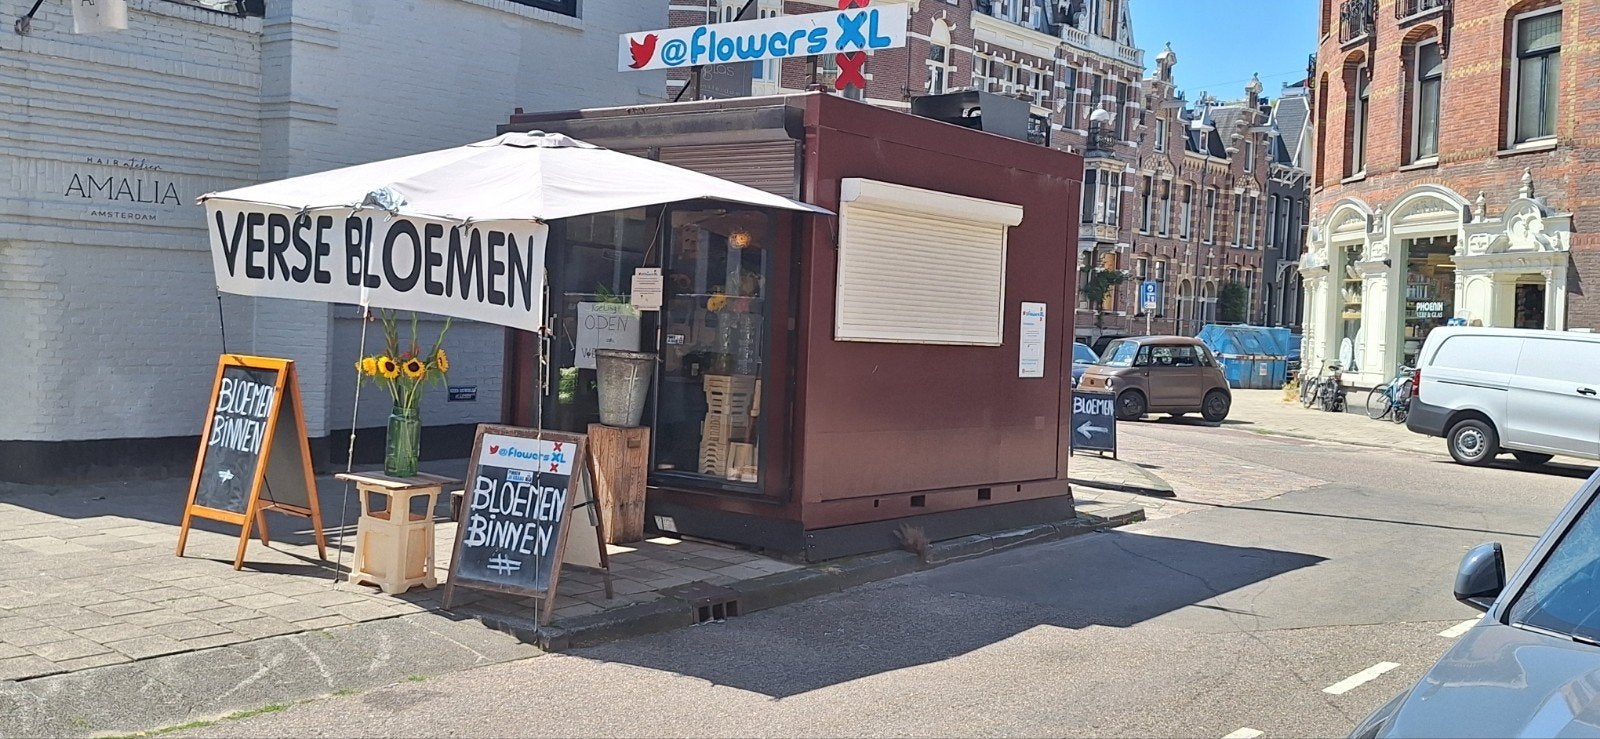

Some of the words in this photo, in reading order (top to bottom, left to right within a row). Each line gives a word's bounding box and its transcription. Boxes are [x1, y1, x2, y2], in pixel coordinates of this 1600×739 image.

[87, 157, 119, 167] HAIR
[123, 158, 162, 171] atelier
[64, 173, 181, 206] AMALIA
[91, 210, 157, 221] AMSTERDAM
[216, 210, 333, 284] VERSE
[345, 216, 534, 312] BLOEMEN
[216, 377, 276, 418] BLOEMEN
[1073, 396, 1115, 416] BLOEMEN
[208, 414, 267, 455] BINNEN
[471, 475, 567, 522] BLOEMEN
[463, 513, 553, 557] BINNEN
